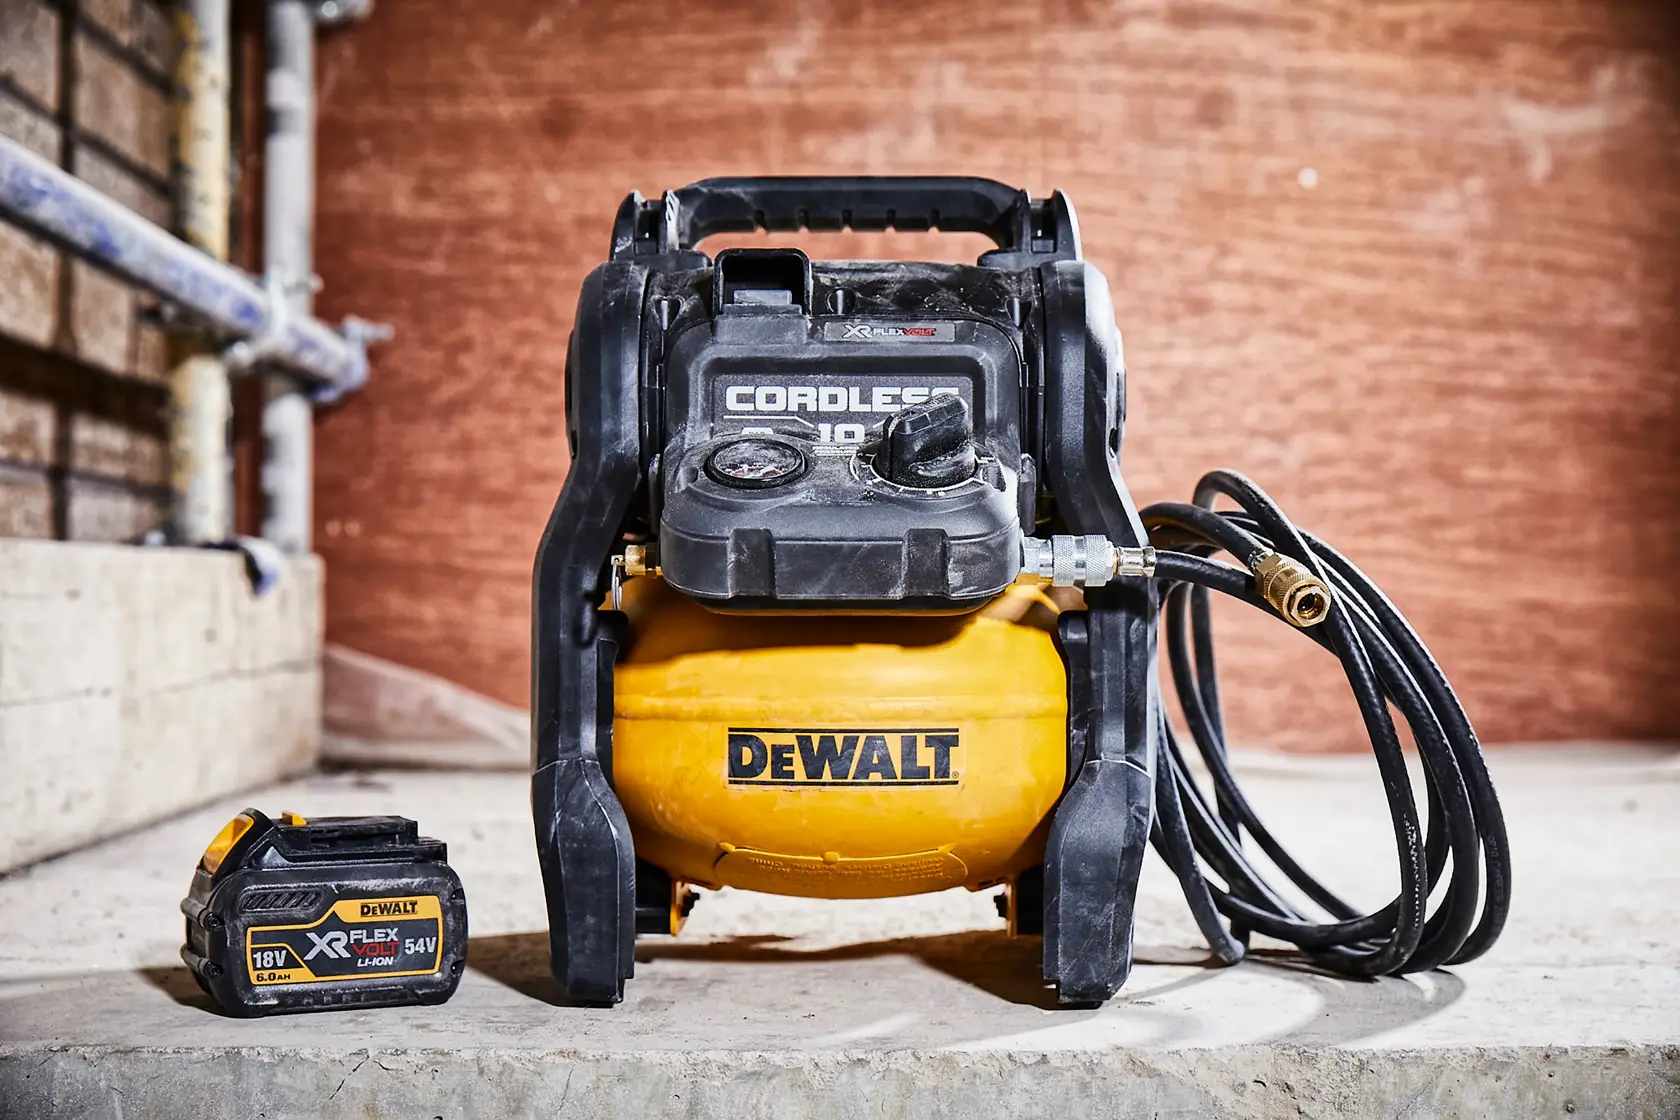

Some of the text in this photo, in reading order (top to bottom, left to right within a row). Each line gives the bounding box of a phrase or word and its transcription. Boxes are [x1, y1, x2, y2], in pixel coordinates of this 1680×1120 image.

[842, 324, 872, 338] XR
[818, 423, 865, 443] 10
[728, 734, 959, 779] DEWALT
[361, 902, 418, 916] DEWALT
[303, 928, 399, 960] XR FLEX
[351, 941, 400, 956] VOLT
[404, 937, 437, 955] 54V
[253, 950, 287, 968] 18V
[357, 957, 395, 967] LI-ION
